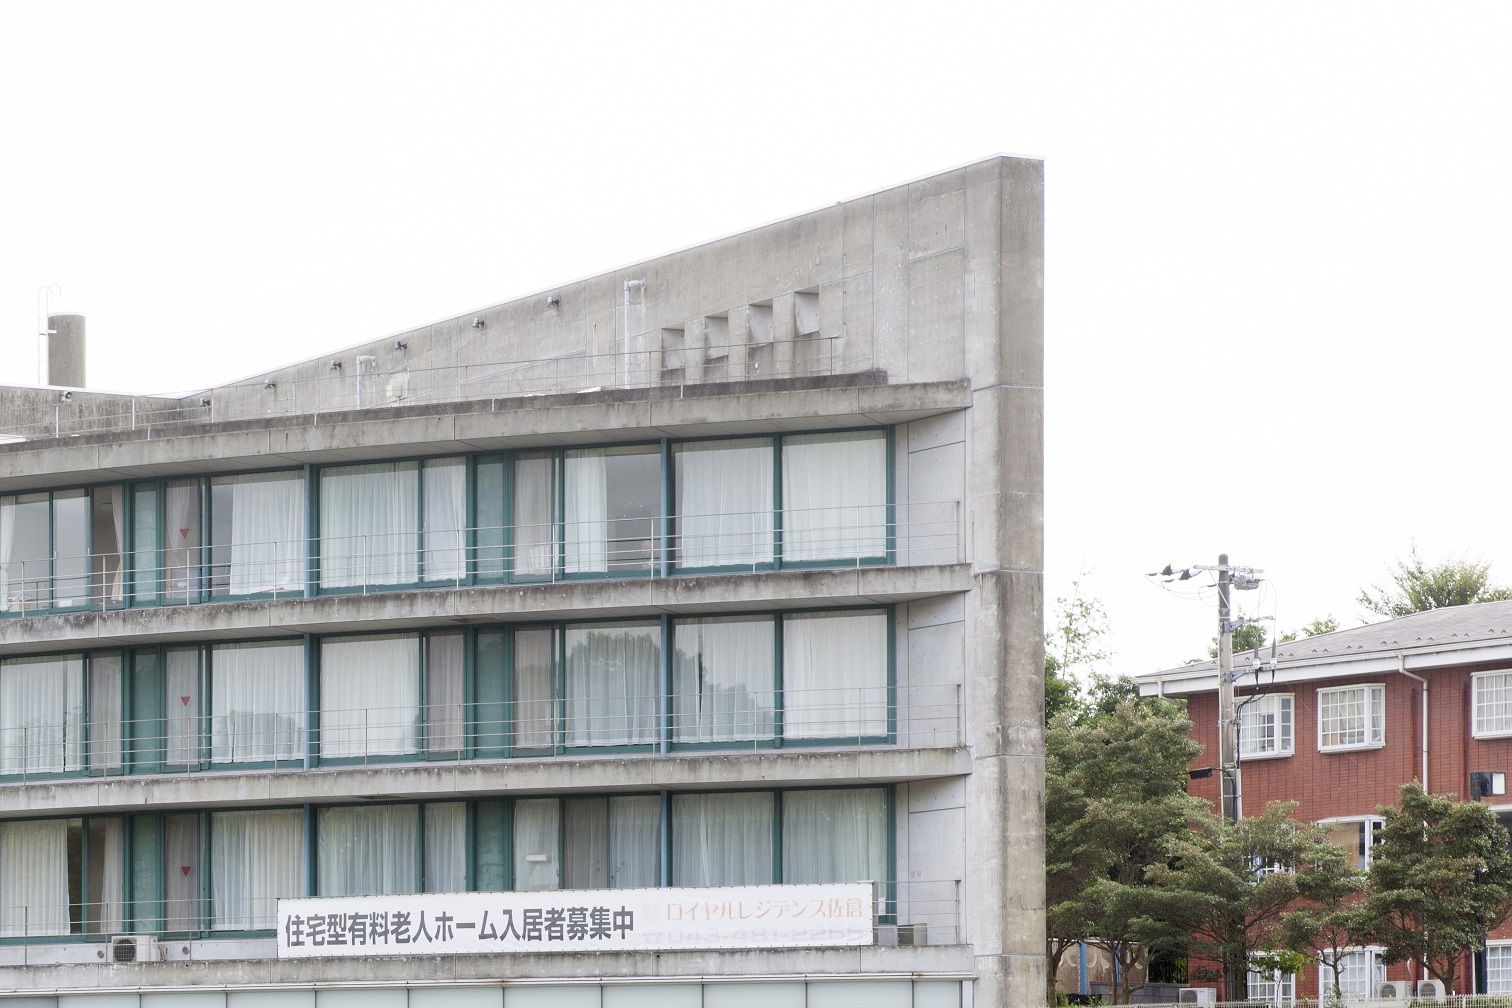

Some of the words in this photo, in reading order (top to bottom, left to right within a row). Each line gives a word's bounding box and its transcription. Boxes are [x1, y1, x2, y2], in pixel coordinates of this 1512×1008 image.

[666, 896, 863, 921] ロイヤルレジデンス佐倉
[285, 905, 634, 948] 住宅型有料老人ホーム入居者募集中
